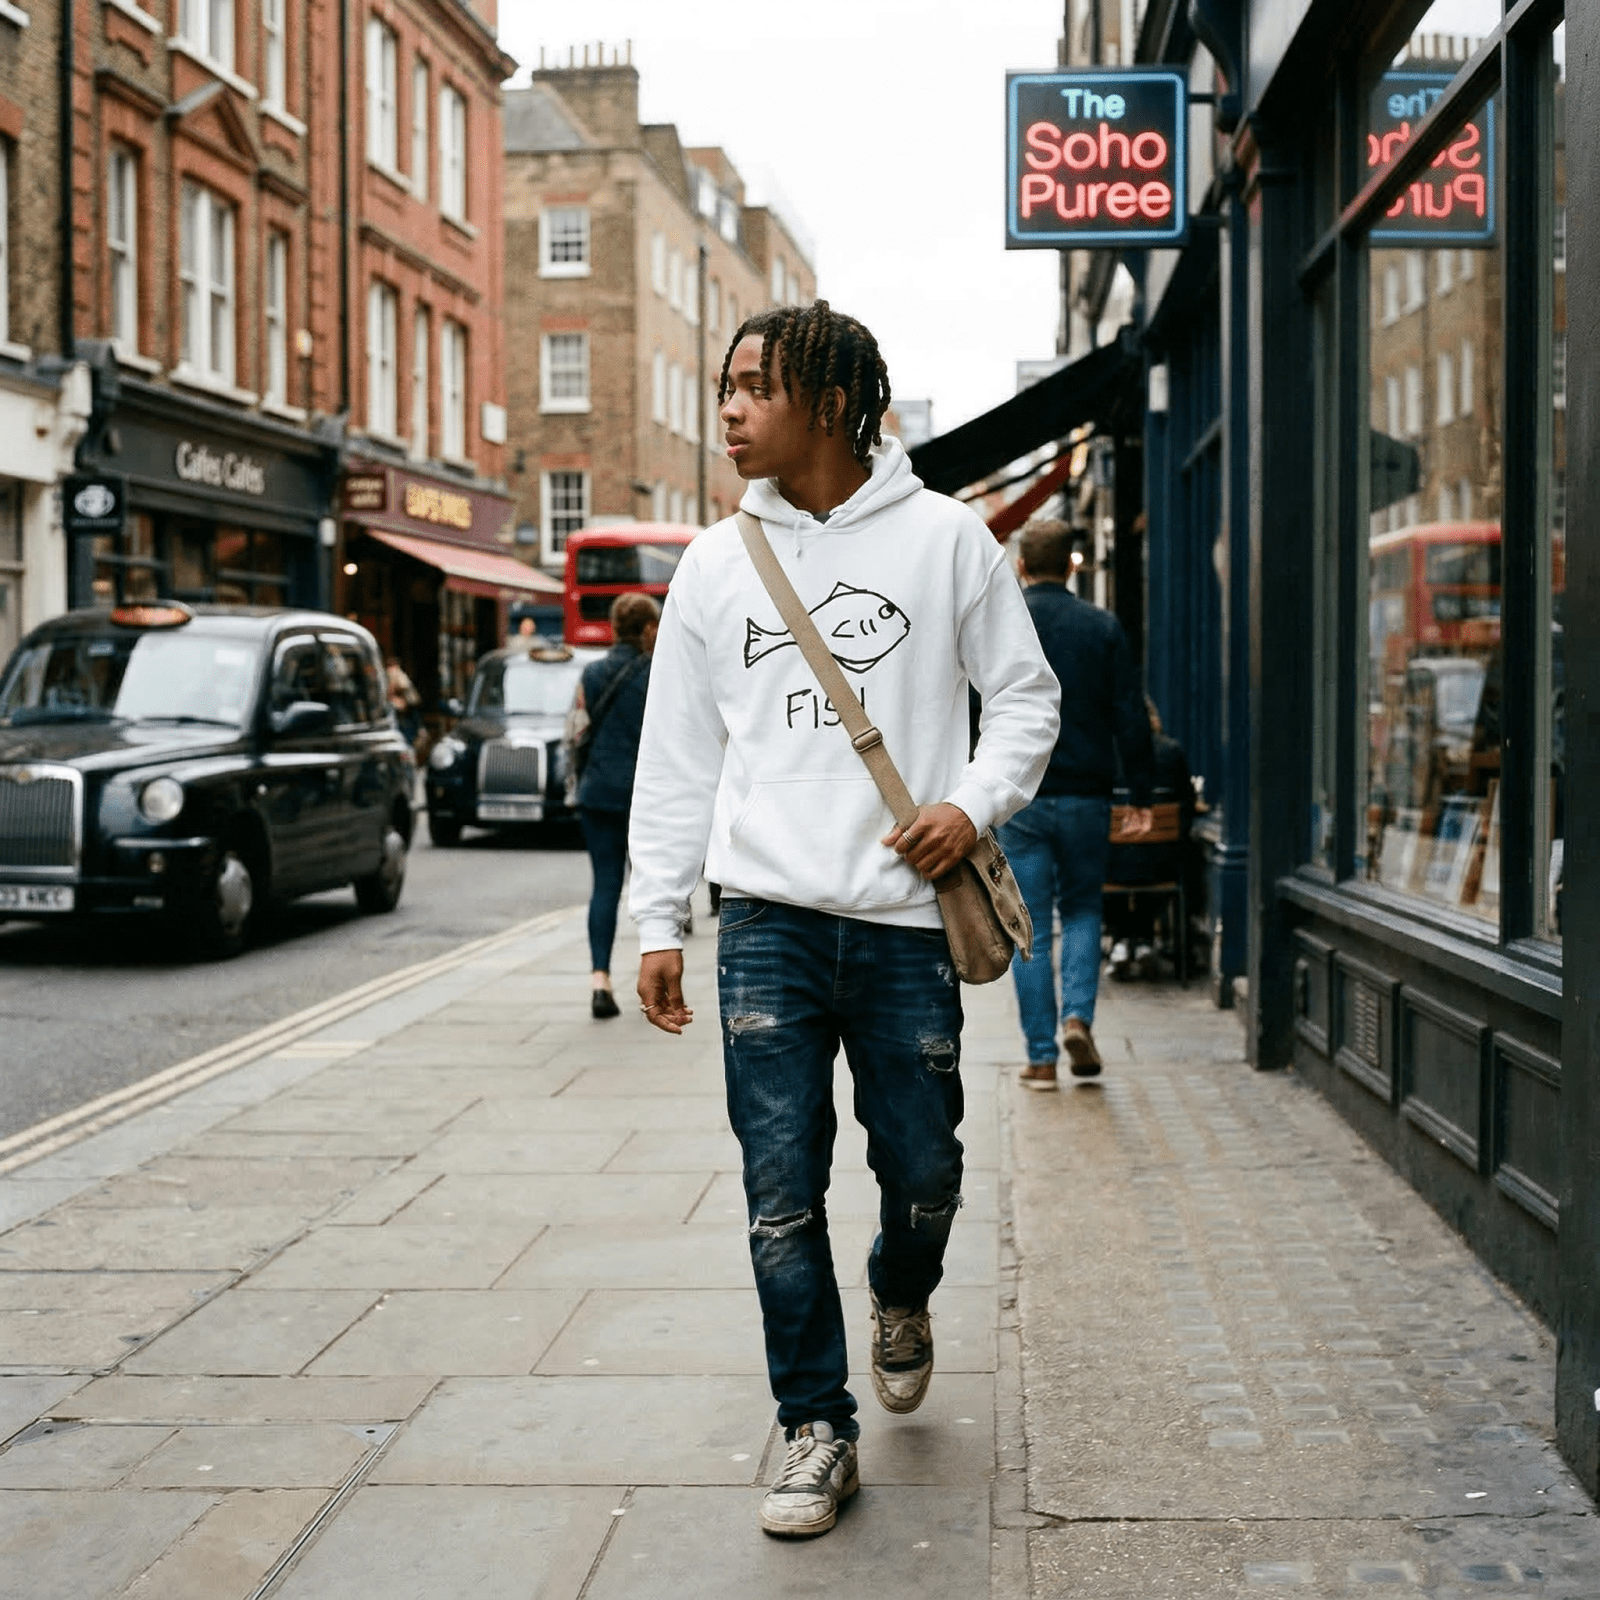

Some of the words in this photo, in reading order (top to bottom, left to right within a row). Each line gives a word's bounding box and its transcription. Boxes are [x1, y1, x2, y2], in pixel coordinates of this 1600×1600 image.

[1060, 88, 1126, 119] The
[1025, 121, 1168, 170] Soho
[1021, 174, 1172, 218] Puree
